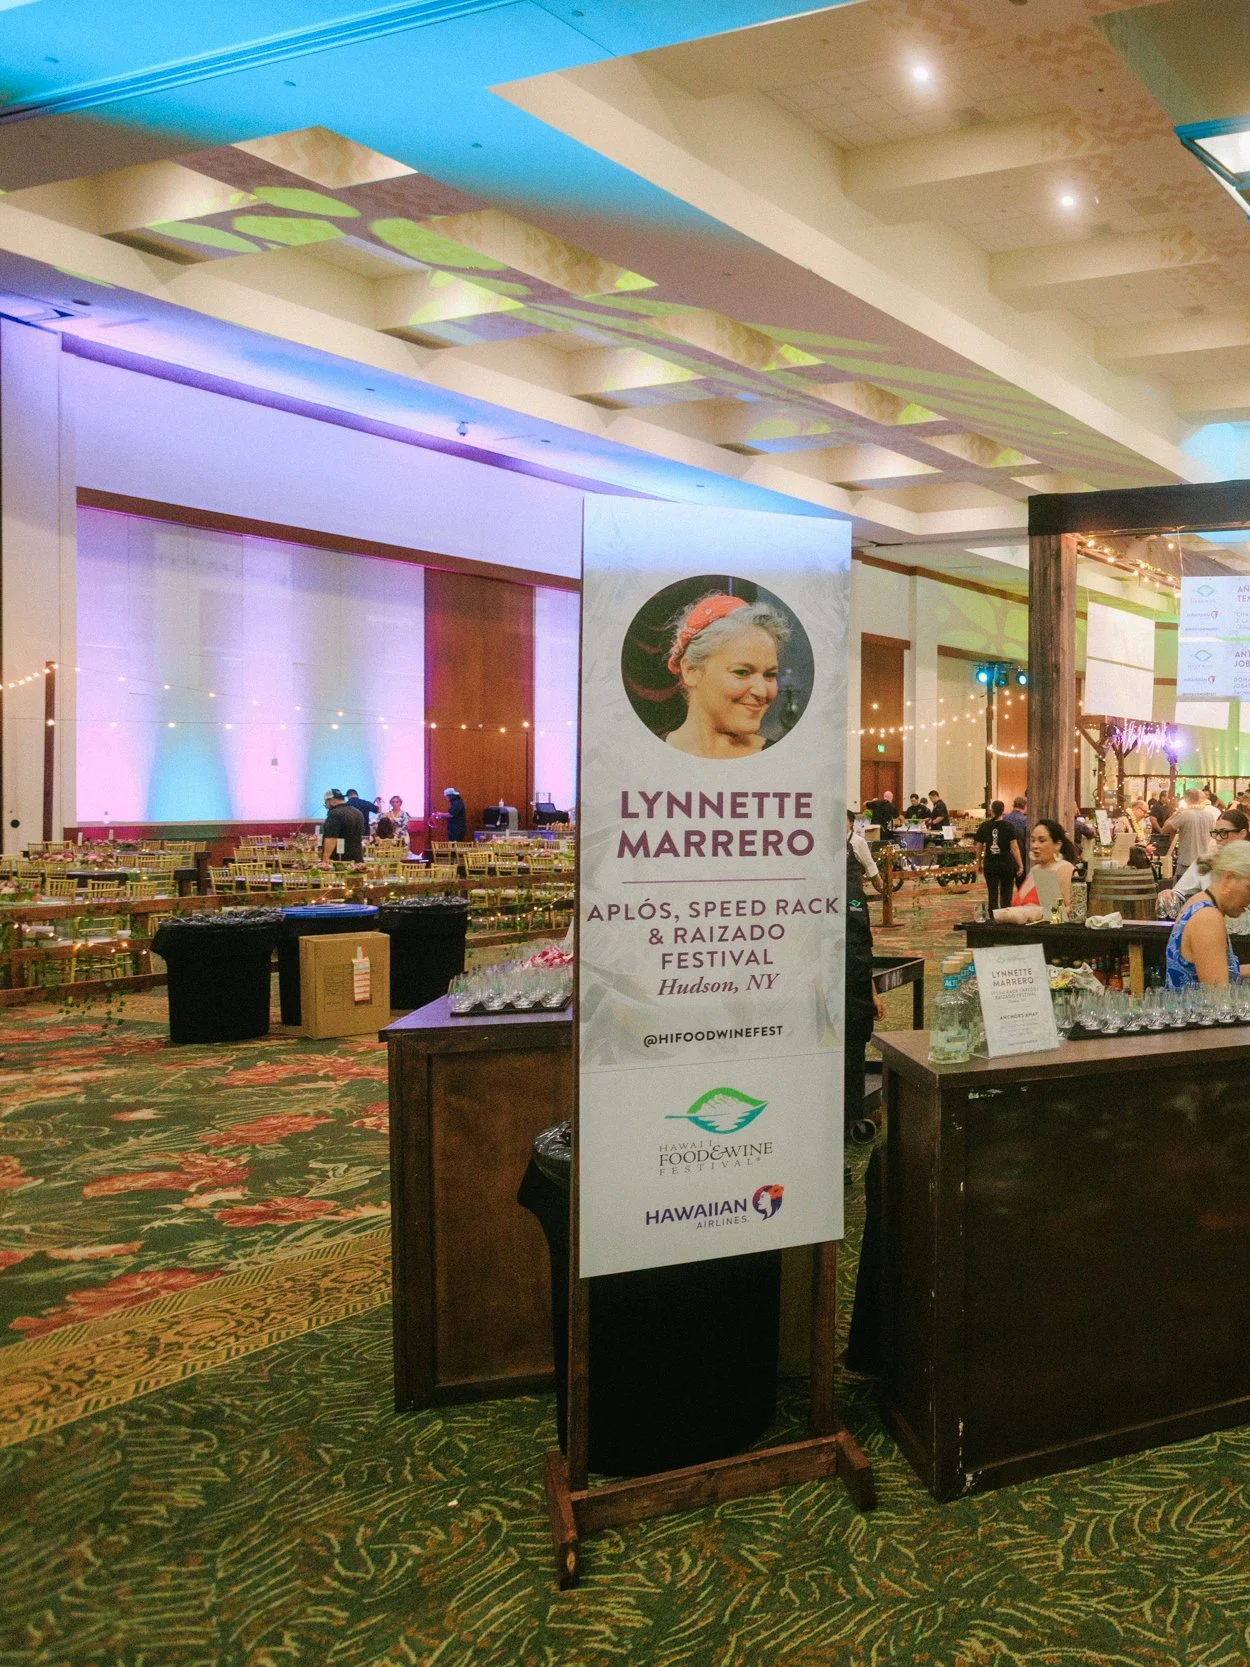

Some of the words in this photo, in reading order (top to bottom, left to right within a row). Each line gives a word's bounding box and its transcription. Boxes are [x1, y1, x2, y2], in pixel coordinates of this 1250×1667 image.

[621, 791, 812, 819] LYNNETTE
[617, 829, 815, 858] MARRERO
[587, 899, 680, 923] APLÓS,
[689, 900, 766, 918] SPEED
[776, 897, 839, 916] RACK
[648, 928, 664, 945] &
[673, 924, 785, 944] RAIZADO
[661, 949, 773, 970] FESTIVAL
[657, 976, 739, 996] Hudson,
[746, 973, 780, 991] NY
[992, 968, 1032, 979] LYNNETTE
[993, 977, 1034, 987] MARRERO
[643, 1026, 783, 1048] @HIFOODWINEFEST
[659, 1140, 713, 1152] HAWAII
[659, 1142, 773, 1166] FOOD&WINE
[645, 1198, 747, 1225] HAWAIIAN
